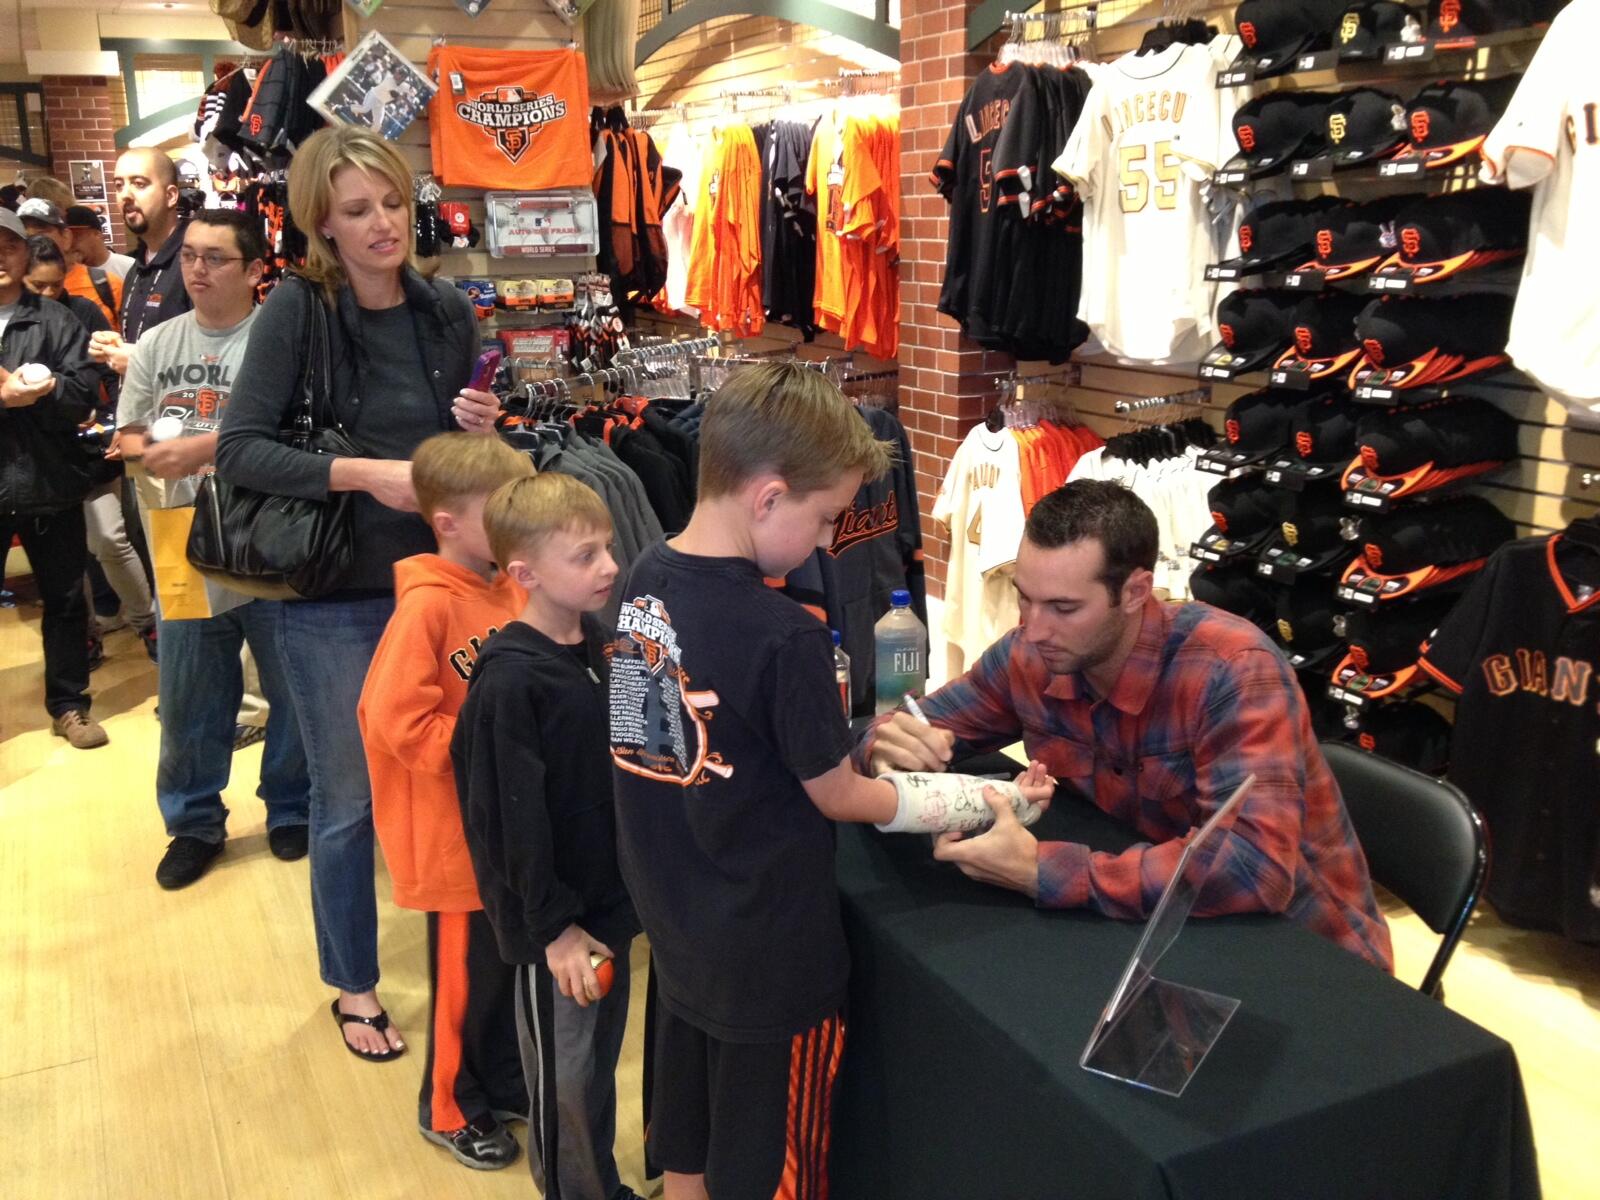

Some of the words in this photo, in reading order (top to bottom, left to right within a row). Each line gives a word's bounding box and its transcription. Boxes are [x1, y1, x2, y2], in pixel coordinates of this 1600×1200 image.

[458, 103, 566, 127] CHAMPIONS
[471, 100, 512, 113] WORLD
[512, 95, 554, 110] SERIES
[1118, 139, 1181, 214] 55
[893, 651, 920, 673] FIJI
